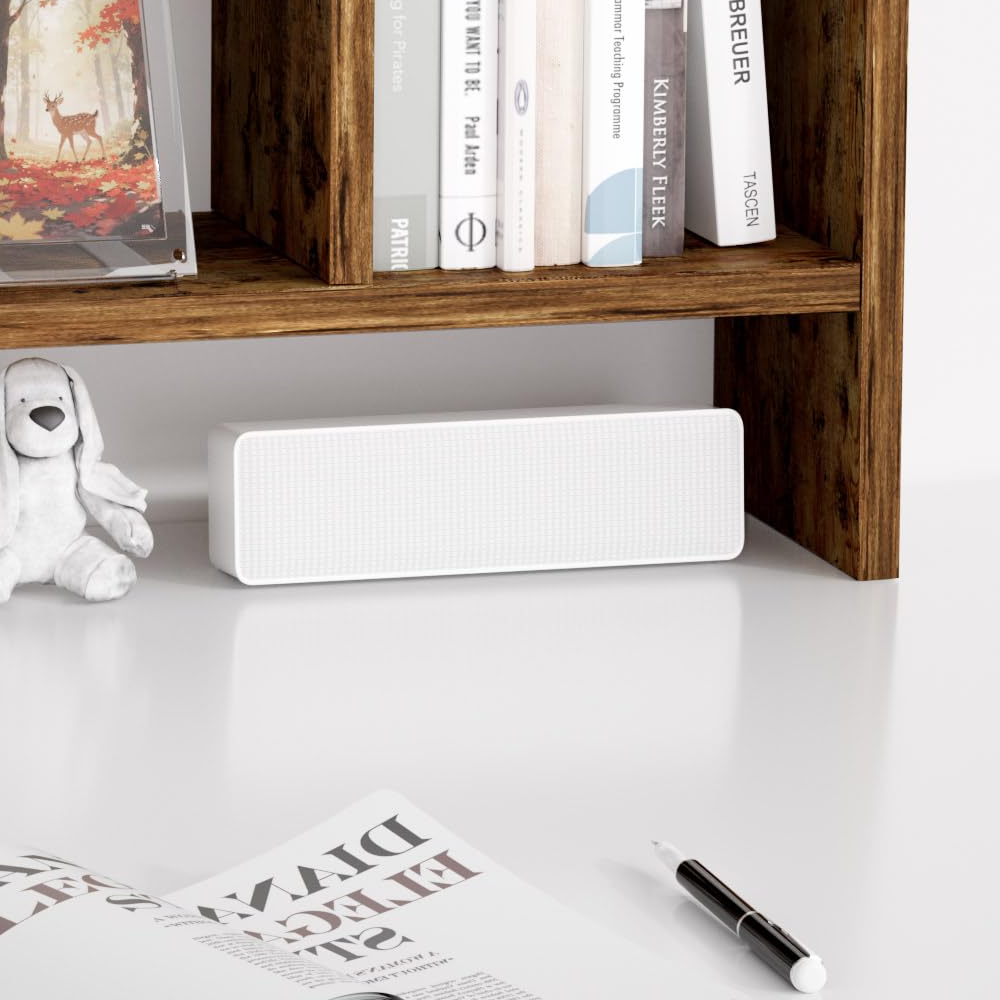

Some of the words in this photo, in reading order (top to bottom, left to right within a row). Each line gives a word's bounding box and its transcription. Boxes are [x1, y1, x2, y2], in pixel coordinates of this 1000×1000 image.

[392, 15, 406, 33] for
[465, 0, 481, 21] YOU
[465, 26, 481, 55] WANT
[611, 36, 625, 78] Teaching
[729, 0, 751, 85] BREUER
[392, 40, 406, 92] Pirates
[464, 61, 480, 73] TO
[464, 79, 480, 96] BE.
[464, 116, 480, 139] Paul
[611, 81, 624, 139] Programme
[652, 78, 669, 169] KIMBERLY
[464, 144, 480, 175] Arden
[651, 176, 668, 229] FLEEK
[743, 171, 760, 227] TASCEN
